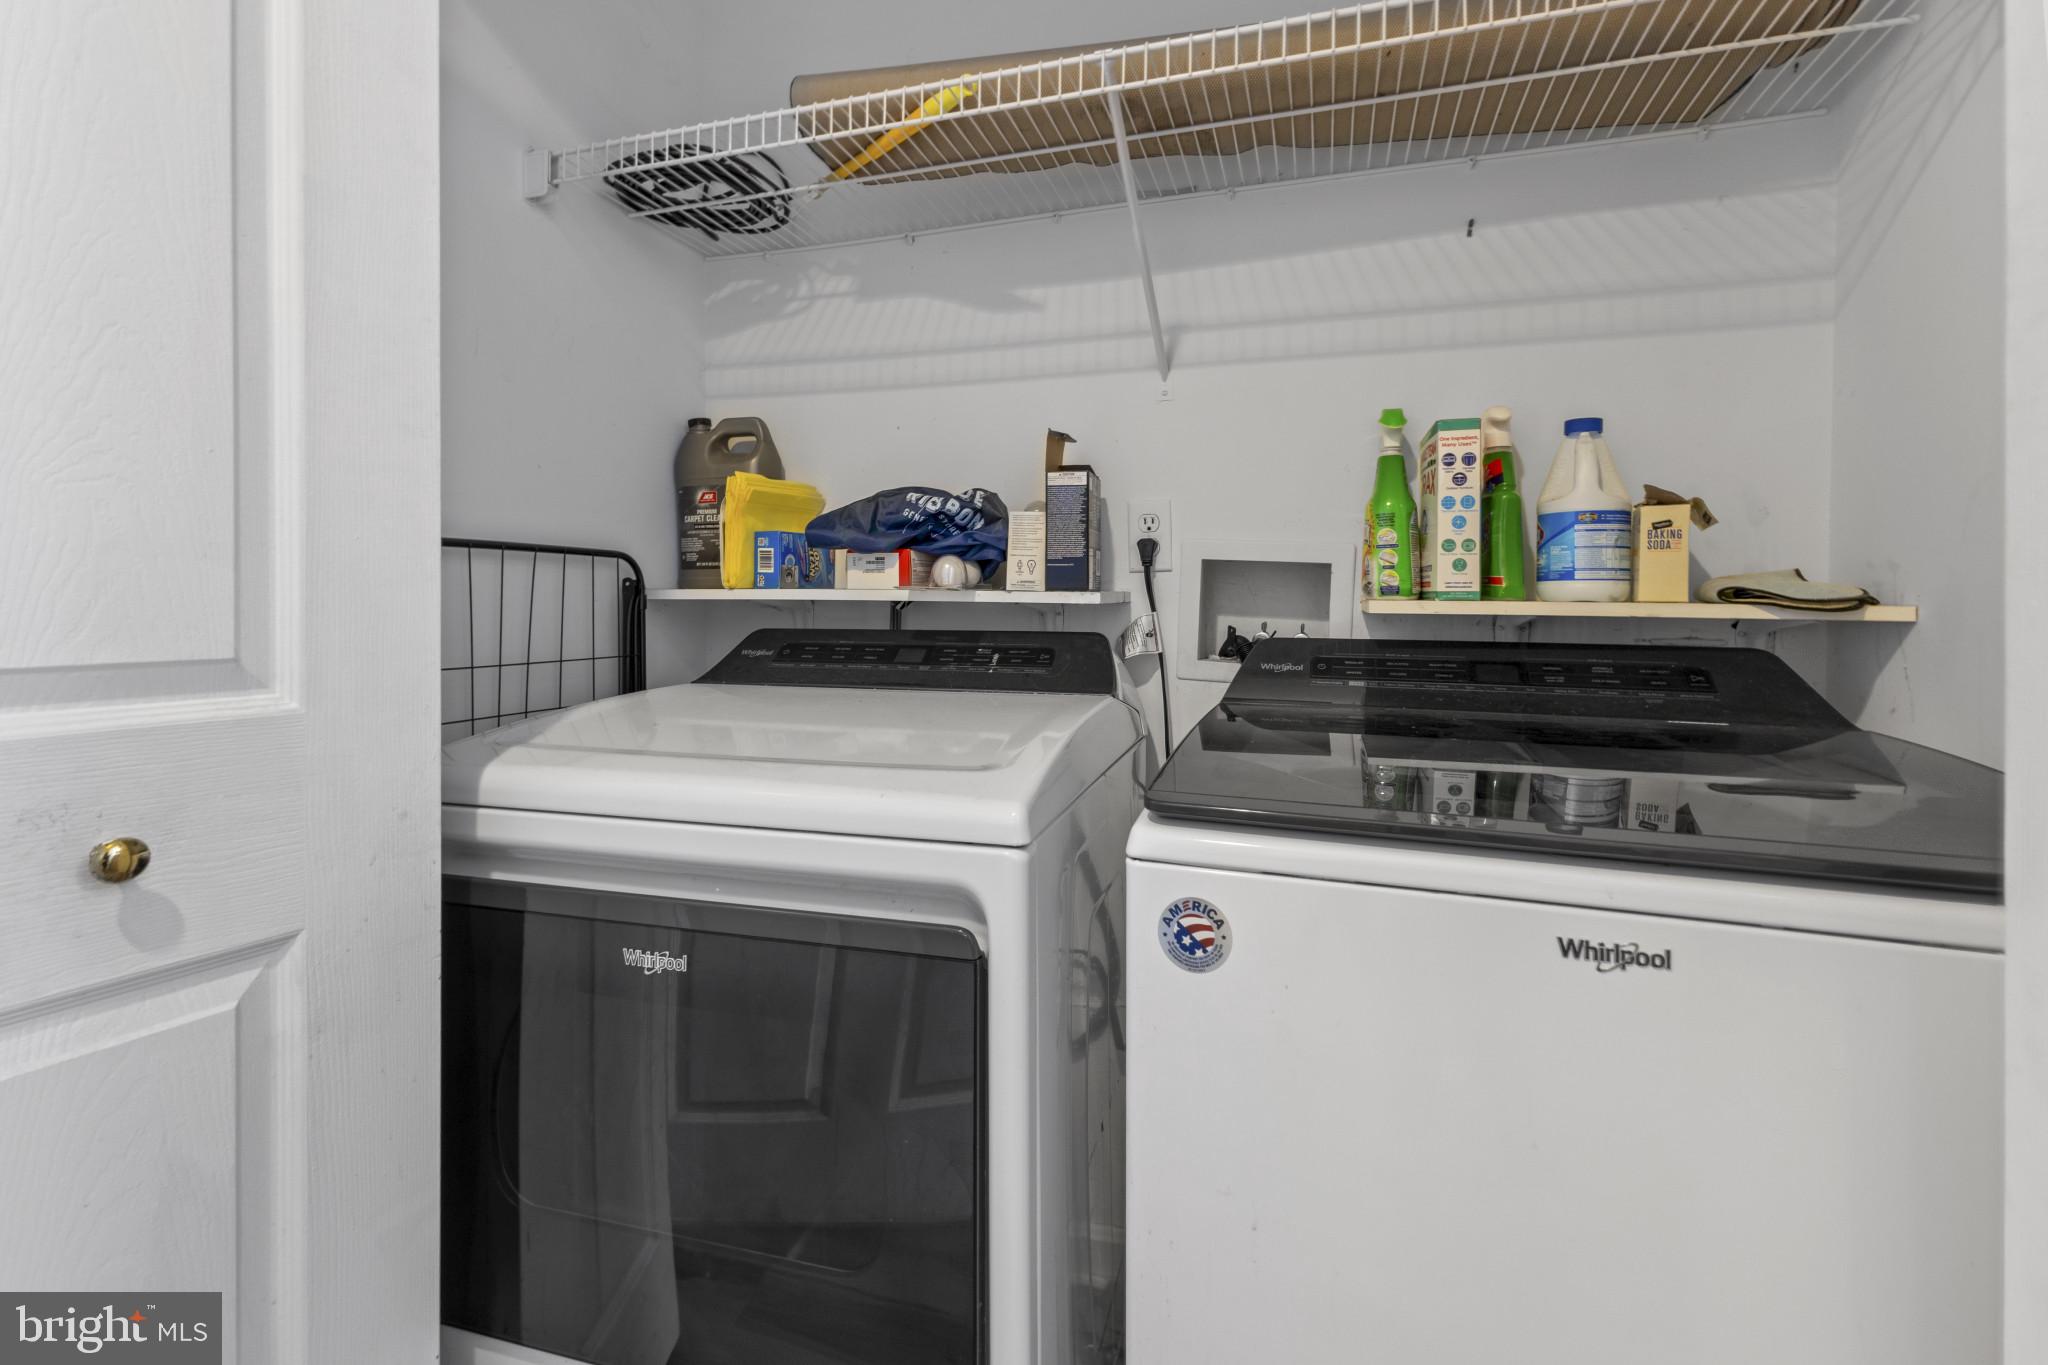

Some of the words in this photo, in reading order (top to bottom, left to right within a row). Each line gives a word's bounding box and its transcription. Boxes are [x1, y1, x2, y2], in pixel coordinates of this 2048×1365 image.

[684, 515, 704, 523] CARPET
[1647, 528, 1682, 539] BAKING
[1647, 540, 1671, 549] SODA
[1261, 663, 1304, 672] Whirlpool
[1162, 900, 1225, 930] AMERICA
[1556, 936, 1671, 973] Whirlpool
[623, 948, 688, 975] Whirlpool
